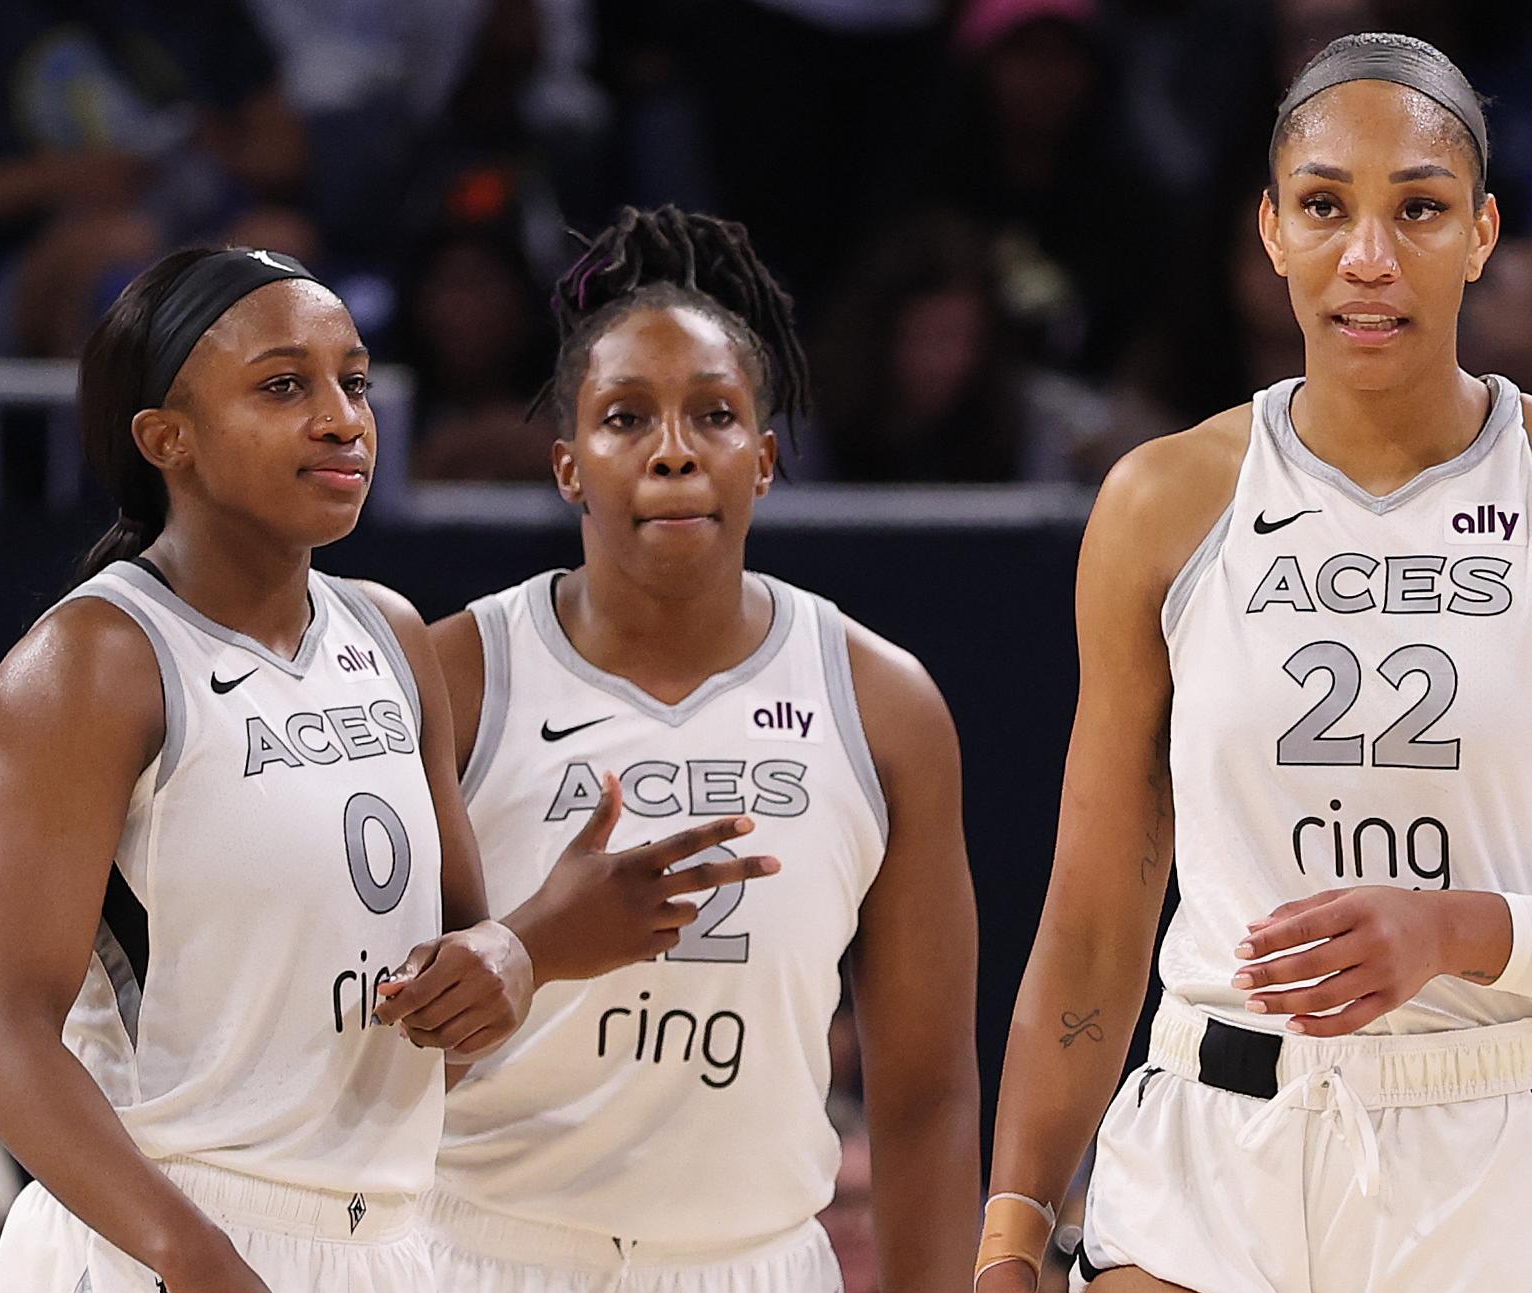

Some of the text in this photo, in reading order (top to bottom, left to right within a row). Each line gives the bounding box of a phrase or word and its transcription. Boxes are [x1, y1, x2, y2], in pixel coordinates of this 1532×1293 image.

[1452, 504, 1519, 540] ally
[1246, 552, 1513, 617] ACES
[337, 645, 378, 678] ally
[243, 699, 415, 777] ACES
[753, 701, 815, 739] ally
[1277, 640, 1461, 770] 22
[544, 759, 811, 823] ACES
[343, 792, 412, 915] 0
[1292, 798, 1451, 891] ring
[637, 840, 749, 964] 2
[597, 990, 746, 1089] ring
